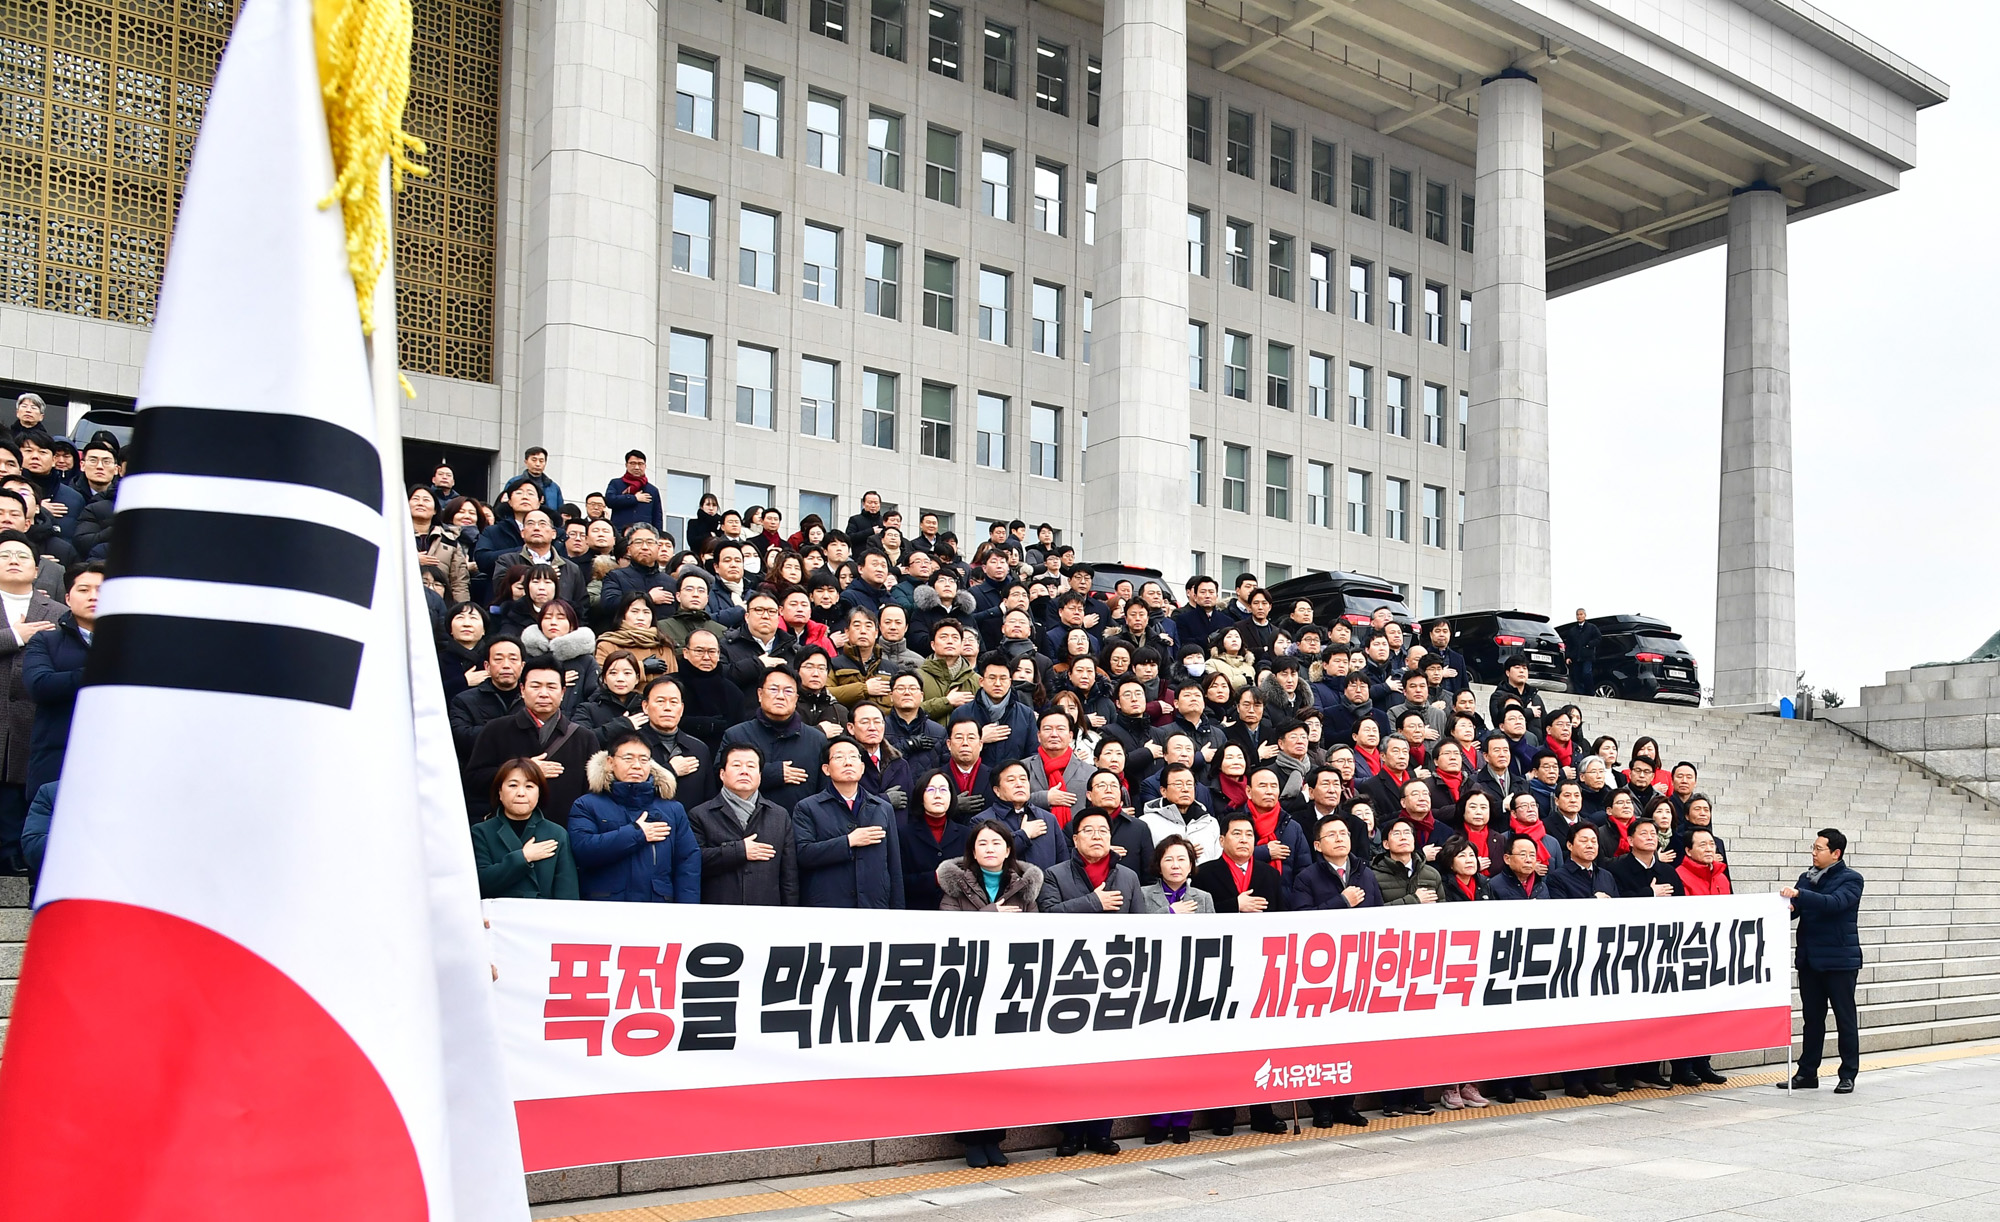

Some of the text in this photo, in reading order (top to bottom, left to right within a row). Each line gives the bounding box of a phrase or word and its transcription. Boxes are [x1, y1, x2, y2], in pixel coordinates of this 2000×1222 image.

[543, 917, 1771, 1057] 폭정을 막지못해 죄송합니다. 자유대한민국 반드시 지키겠습니다.
[1271, 1060, 1353, 1089] 자유한국당
